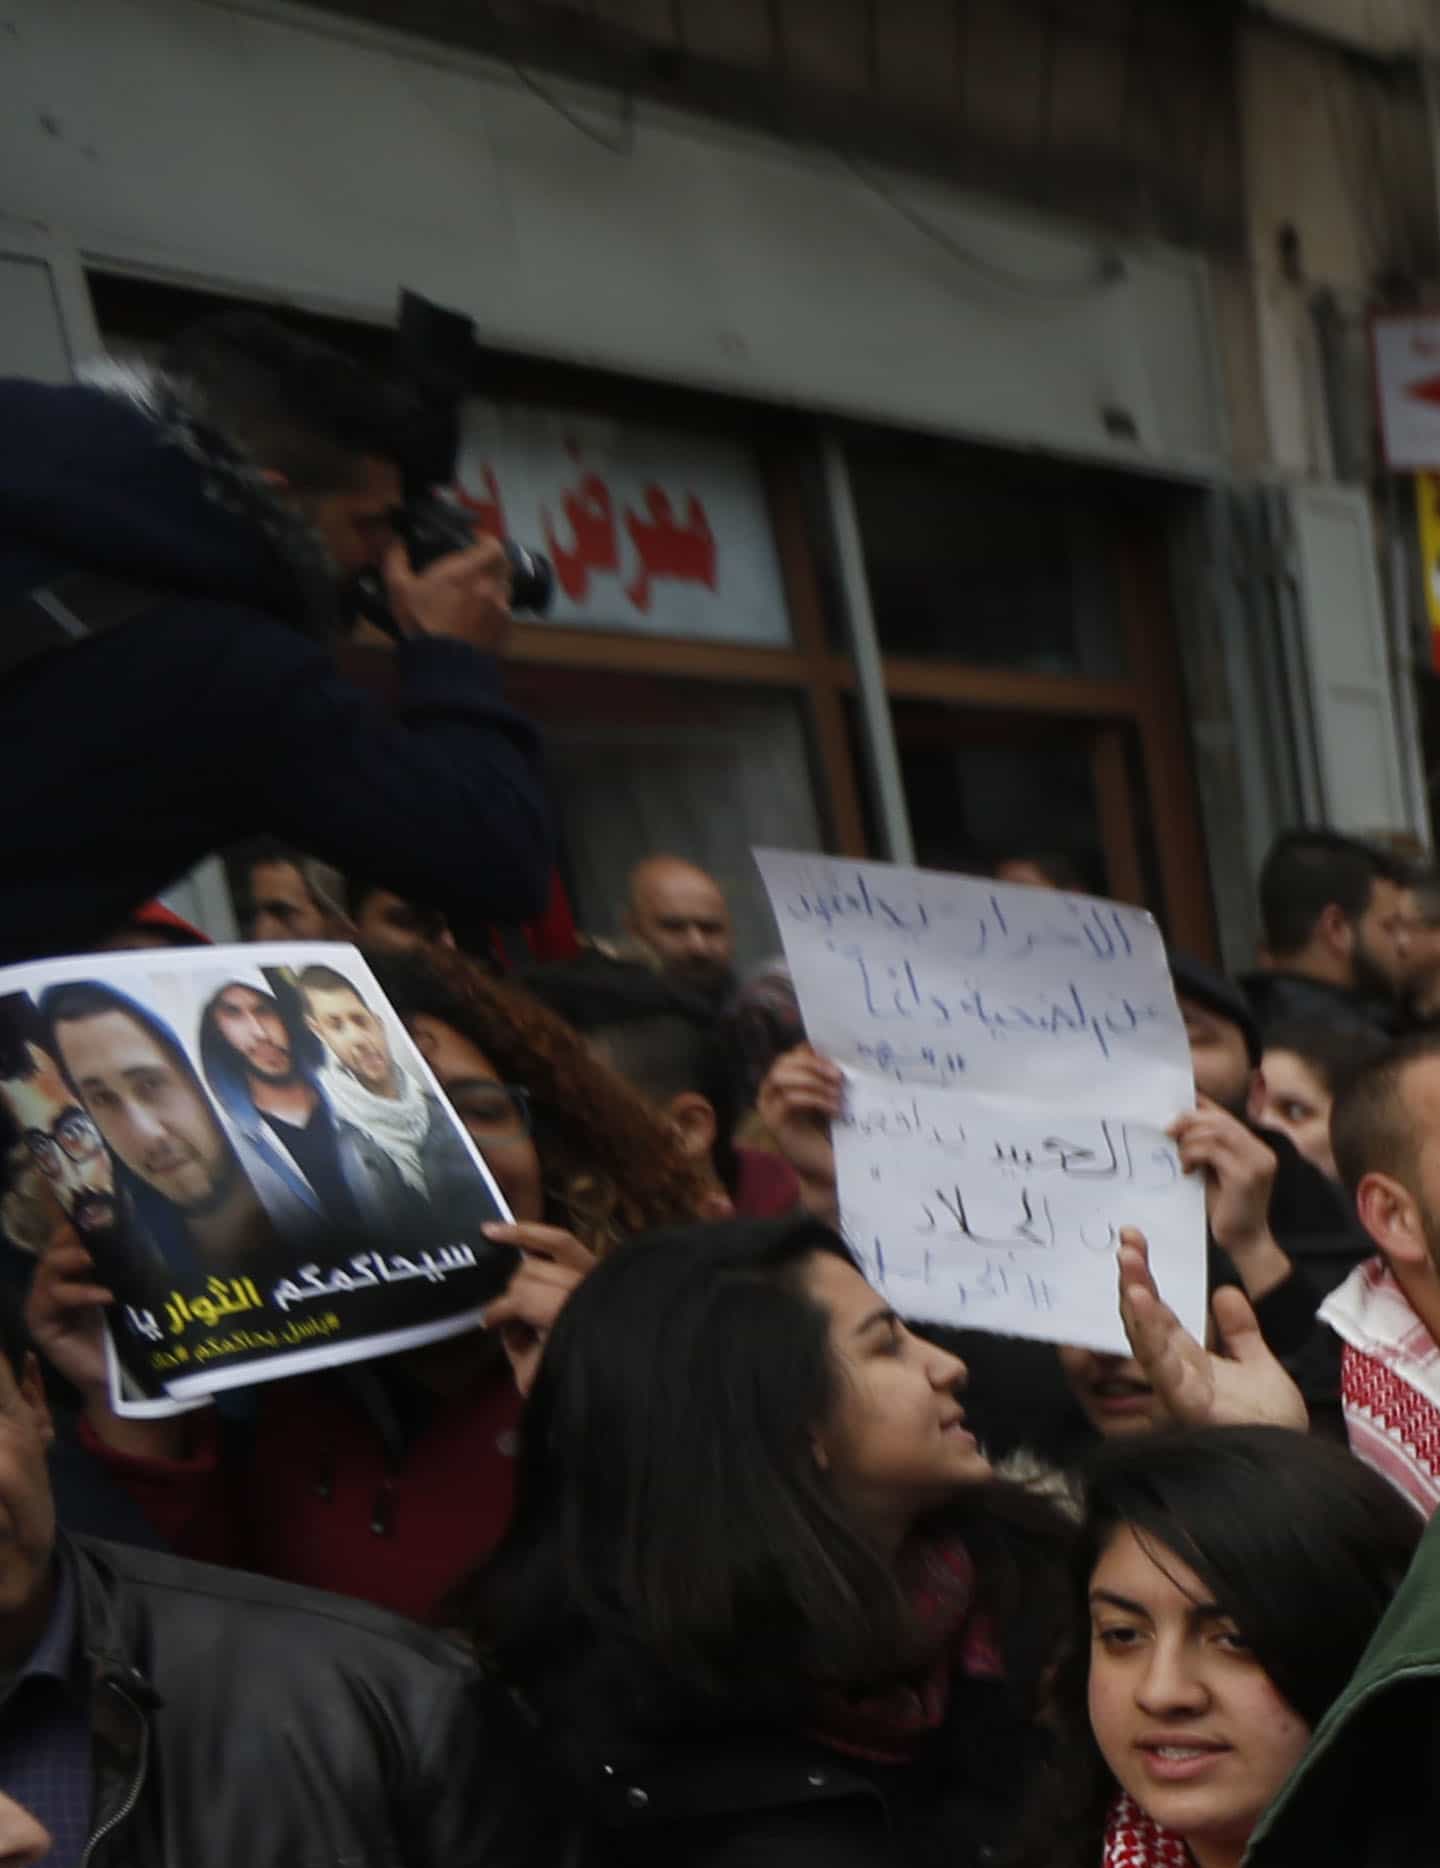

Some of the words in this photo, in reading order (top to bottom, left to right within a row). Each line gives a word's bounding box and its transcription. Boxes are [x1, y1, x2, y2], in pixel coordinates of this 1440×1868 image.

[541, 432, 720, 616] معرض
[162, 1273, 265, 1337] الثوار
[272, 1242, 478, 1313] سيحاكمكم
